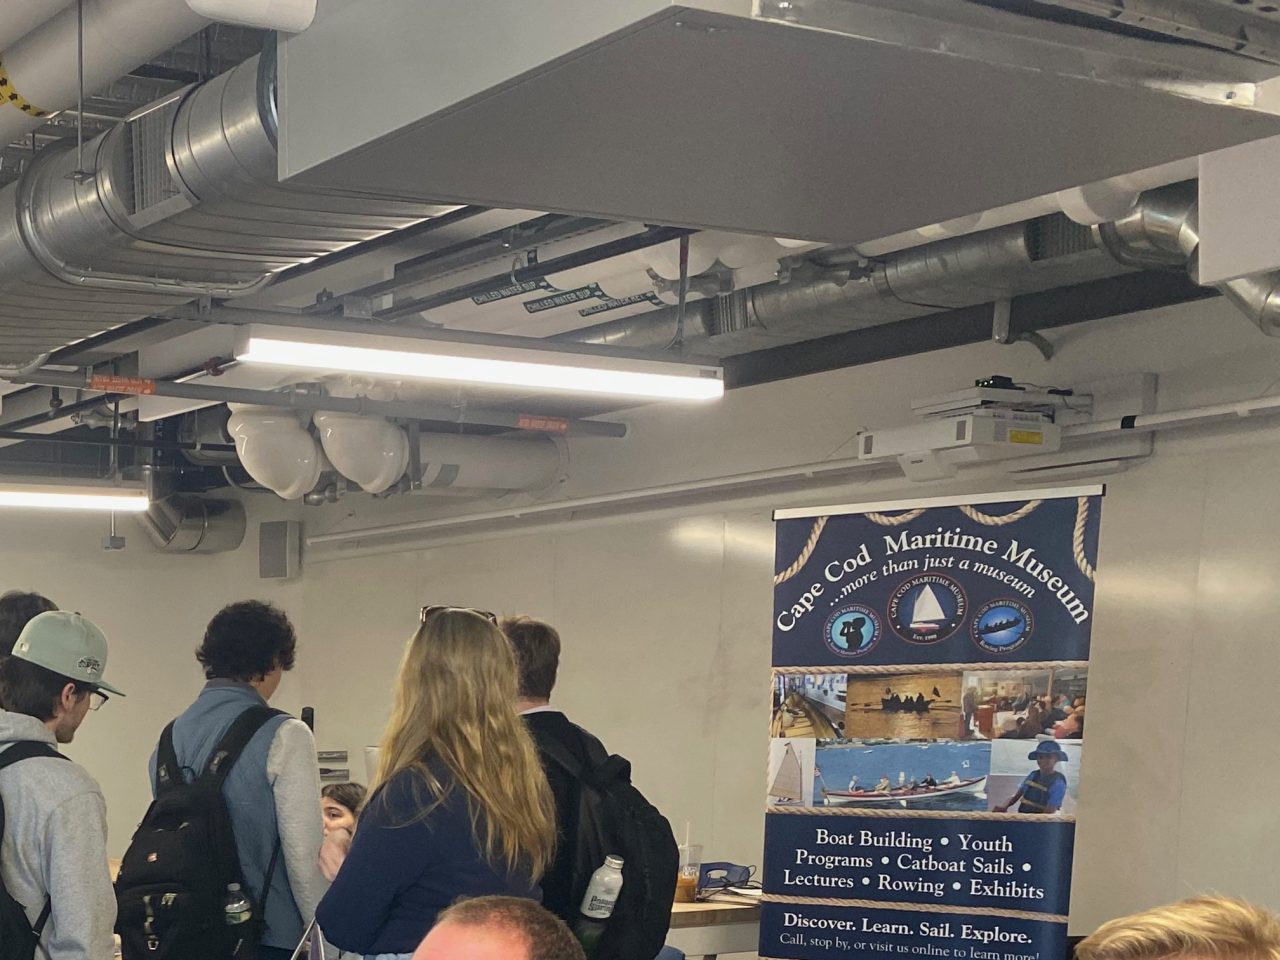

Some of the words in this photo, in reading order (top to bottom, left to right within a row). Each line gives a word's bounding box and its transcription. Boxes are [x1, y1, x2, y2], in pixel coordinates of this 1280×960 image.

[526, 297, 554, 312] CHILLED
[555, 292, 577, 306] WATER
[776, 582, 825, 632] Cape
[824, 543, 873, 582] Cod
[883, 526, 998, 556] Maritime
[1001, 539, 1090, 625] Museum
[882, 558, 919, 576] than
[923, 554, 955, 571] just
[958, 559, 970, 570] a
[973, 562, 1037, 599] museum
[891, 597, 899, 618] CAPE
[897, 582, 911, 597] COD
[912, 576, 951, 587] MARITIME
[948, 583, 965, 616] MUSEUM
[816, 829, 854, 846] Boat
[859, 830, 933, 852] Building
[958, 833, 1013, 852] Youth
[795, 849, 873, 869] Programs
[897, 854, 966, 873] Catboat
[972, 857, 1013, 875] Sails
[784, 870, 854, 888] Lectures
[878, 874, 945, 896] Rowing
[970, 879, 1045, 900] Exhibits
[783, 912, 856, 931] Discover.
[862, 918, 914, 935] Learn.
[919, 922, 954, 939] Sail.
[961, 925, 1032, 945] Explore.
[779, 933, 807, 947] Call,
[810, 936, 832, 950] stop
[835, 937, 851, 951] by,
[854, 941, 867, 951] or
[870, 941, 893, 952] visit
[897, 944, 909, 954] us
[912, 943, 950, 957] online
[953, 947, 967, 958] to
[970, 946, 1001, 960] learn
